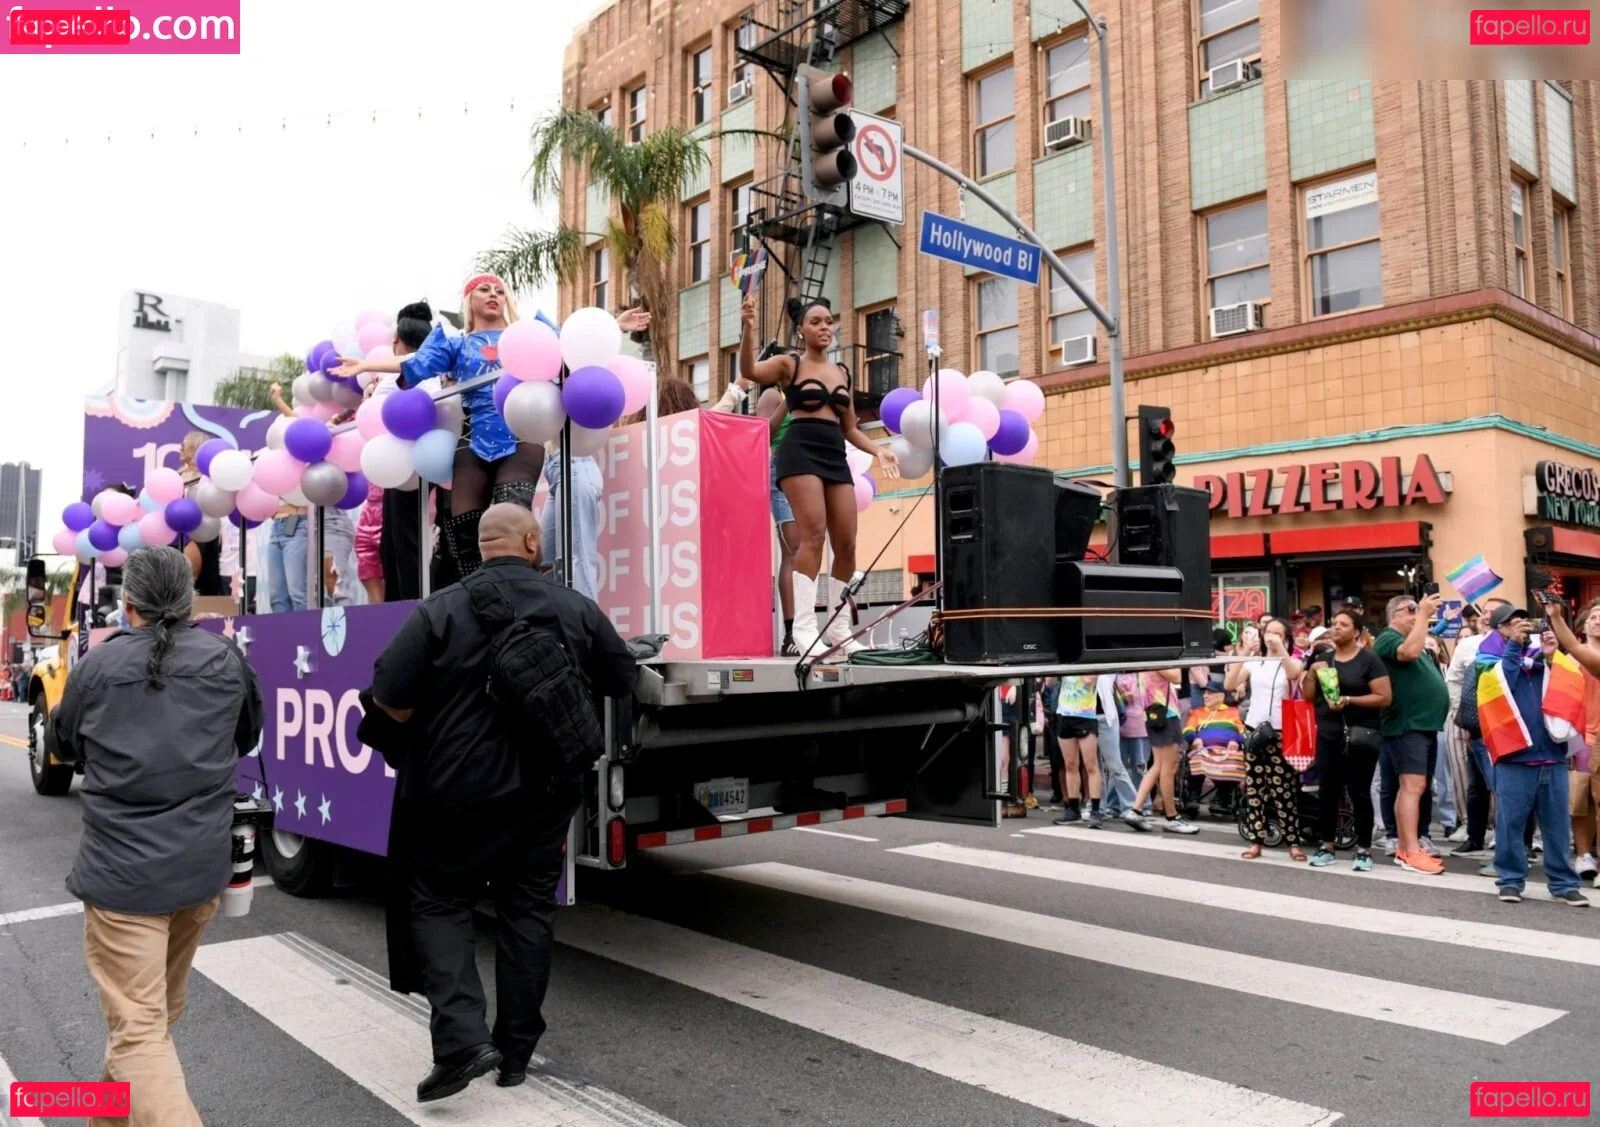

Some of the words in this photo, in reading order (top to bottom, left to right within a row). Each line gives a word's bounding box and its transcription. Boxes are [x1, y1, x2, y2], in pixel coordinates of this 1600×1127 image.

[862, 184, 874, 195] PM
[881, 188, 887, 199] 7
[888, 191, 899, 201] PM
[1308, 180, 1374, 204] STARMEN
[930, 222, 1012, 267] Hollywood
[1017, 249, 1033, 272] Bl
[598, 434, 629, 479] F
[641, 419, 697, 471] US
[642, 480, 698, 529] US
[1193, 454, 1446, 518] PIZZERIA
[1546, 493, 1570, 521] NEW
[1572, 501, 1600, 528] YORK
[643, 540, 699, 589] US
[643, 602, 700, 650] US
[276, 687, 397, 778] PRO
